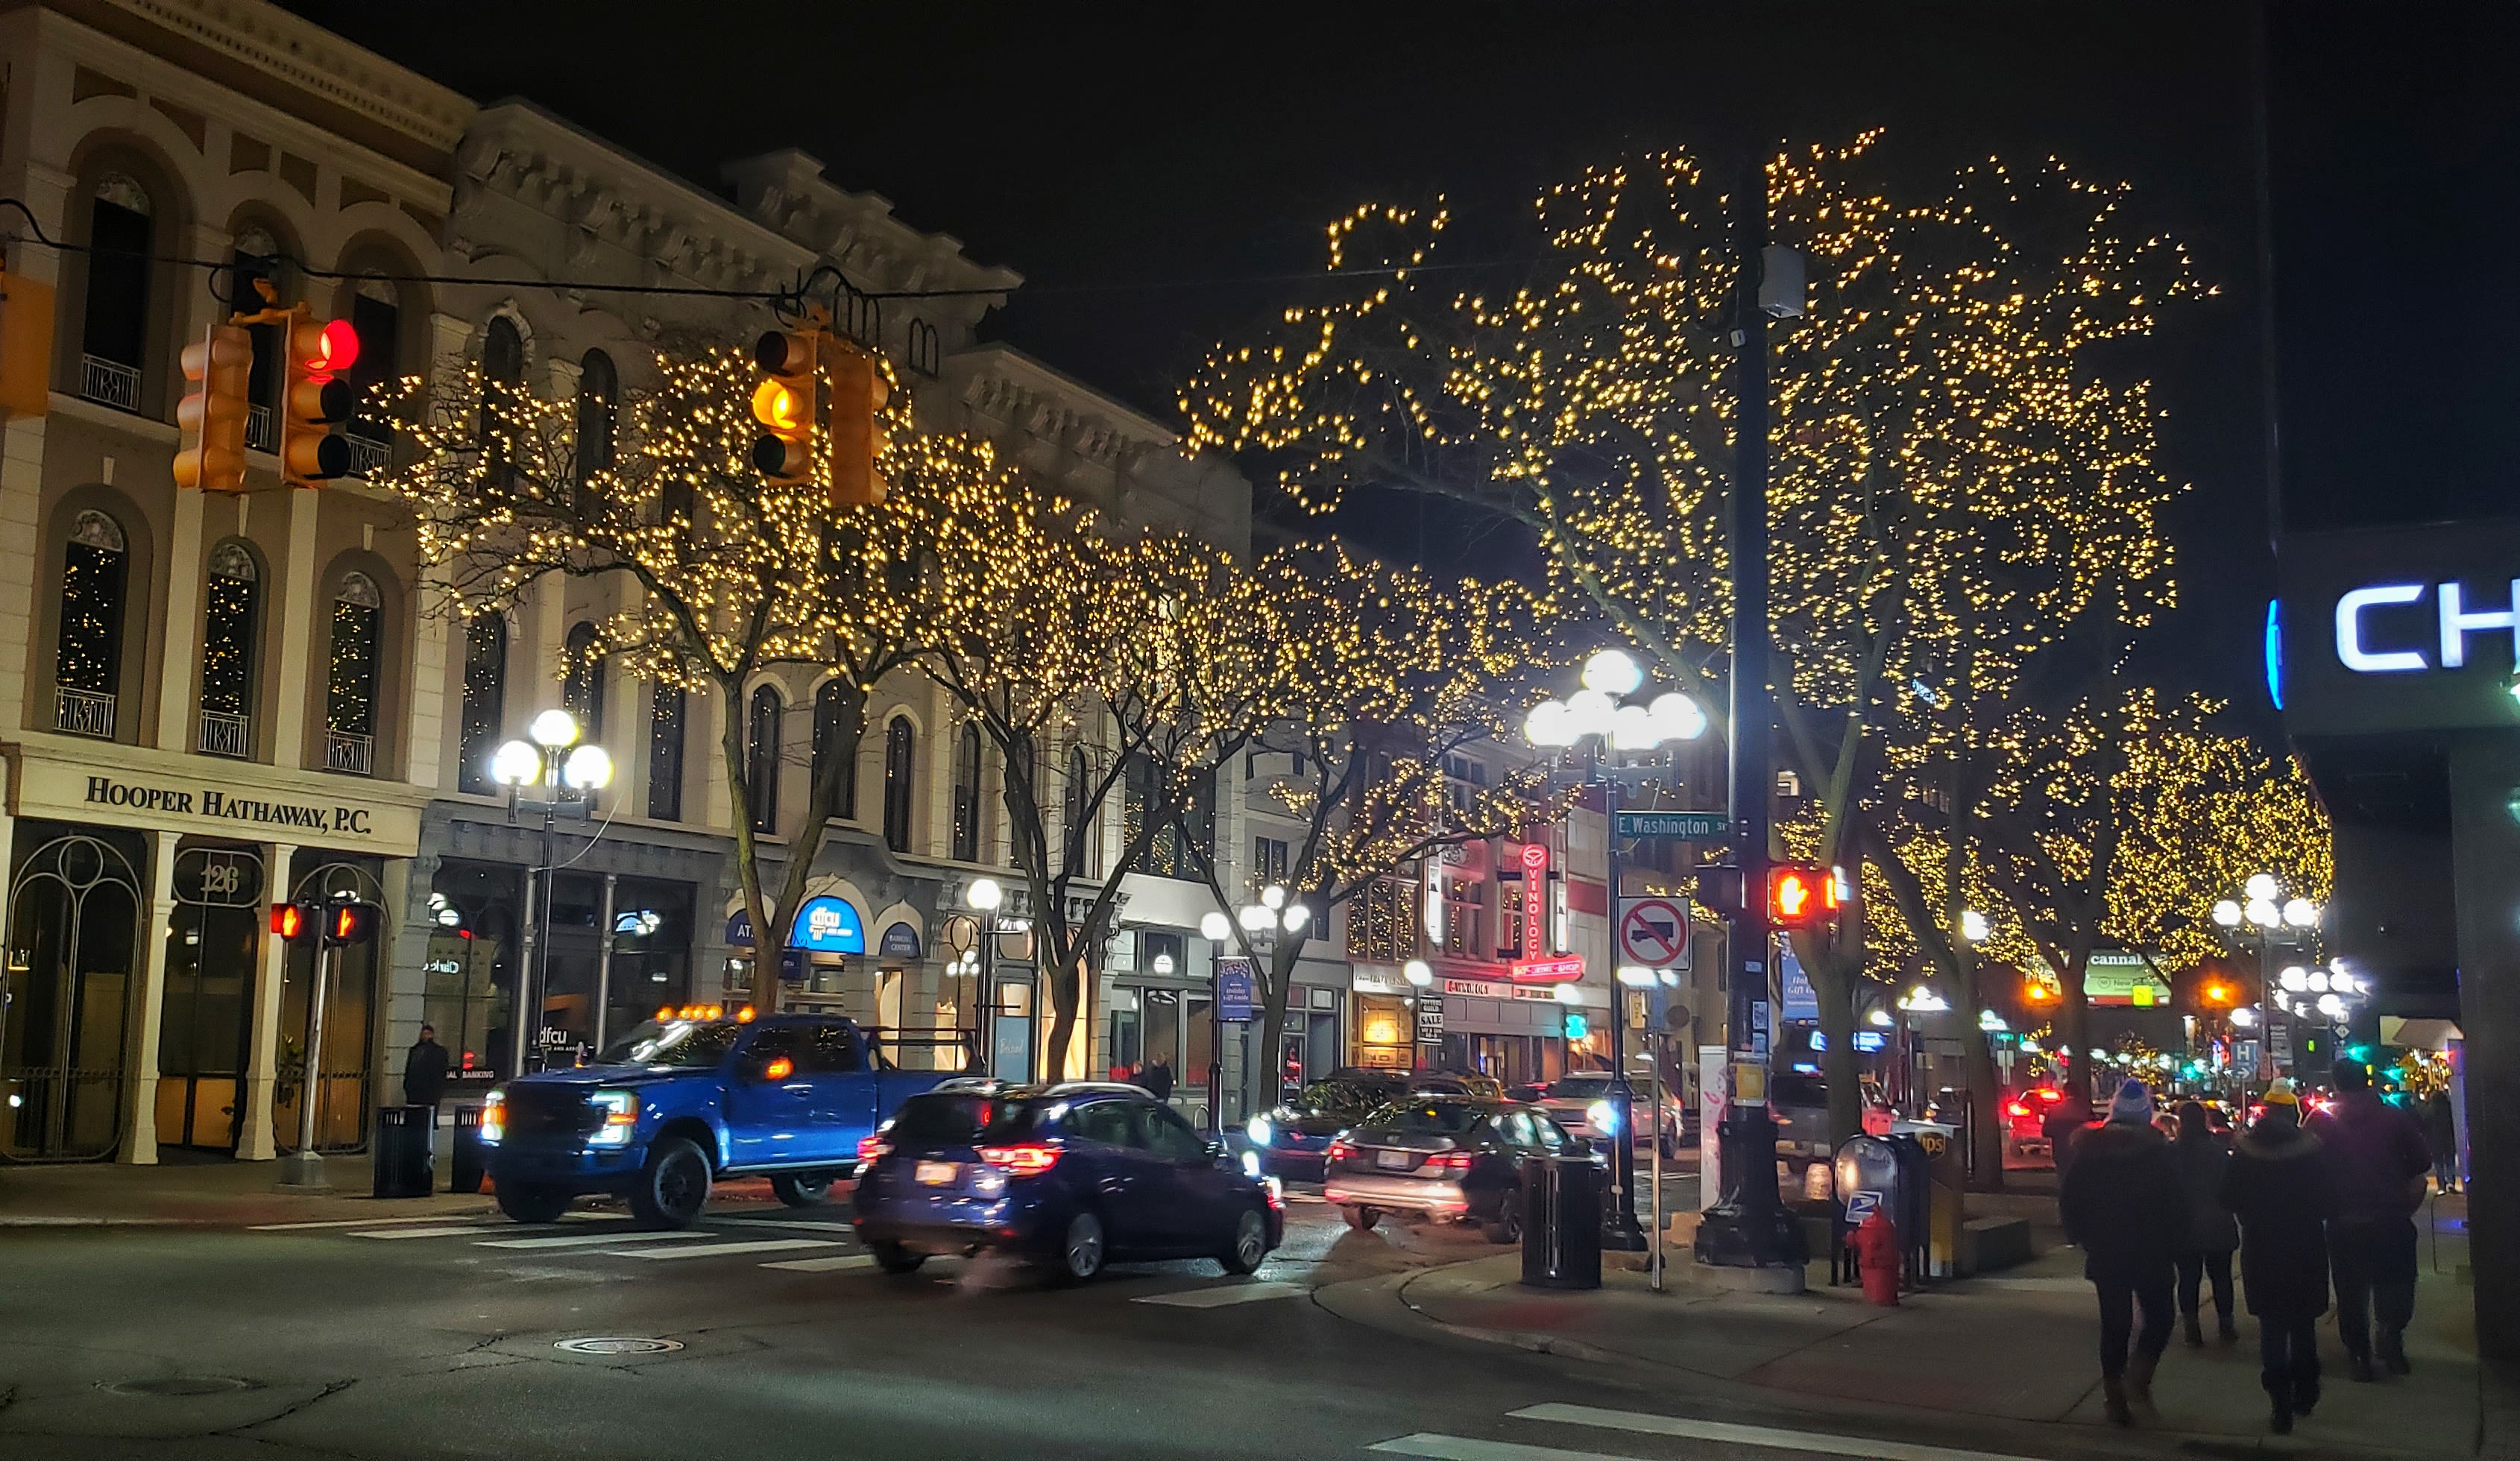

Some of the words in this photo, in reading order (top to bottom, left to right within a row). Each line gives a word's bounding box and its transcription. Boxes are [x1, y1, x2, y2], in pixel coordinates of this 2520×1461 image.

[85, 776, 192, 813] HOOPER
[333, 807, 371, 833] P.C.
[1633, 817, 1709, 839] Washington
[200, 865, 239, 893] 126
[809, 906, 841, 927] dfcu
[1528, 869, 1540, 960] VINOLOGY
[737, 924, 755, 938] AT
[1421, 1015, 1442, 1025] SALE
[539, 1026, 567, 1044] dfcu
[2237, 1045, 2250, 1061] H
[462, 1070, 494, 1079] BANKING
